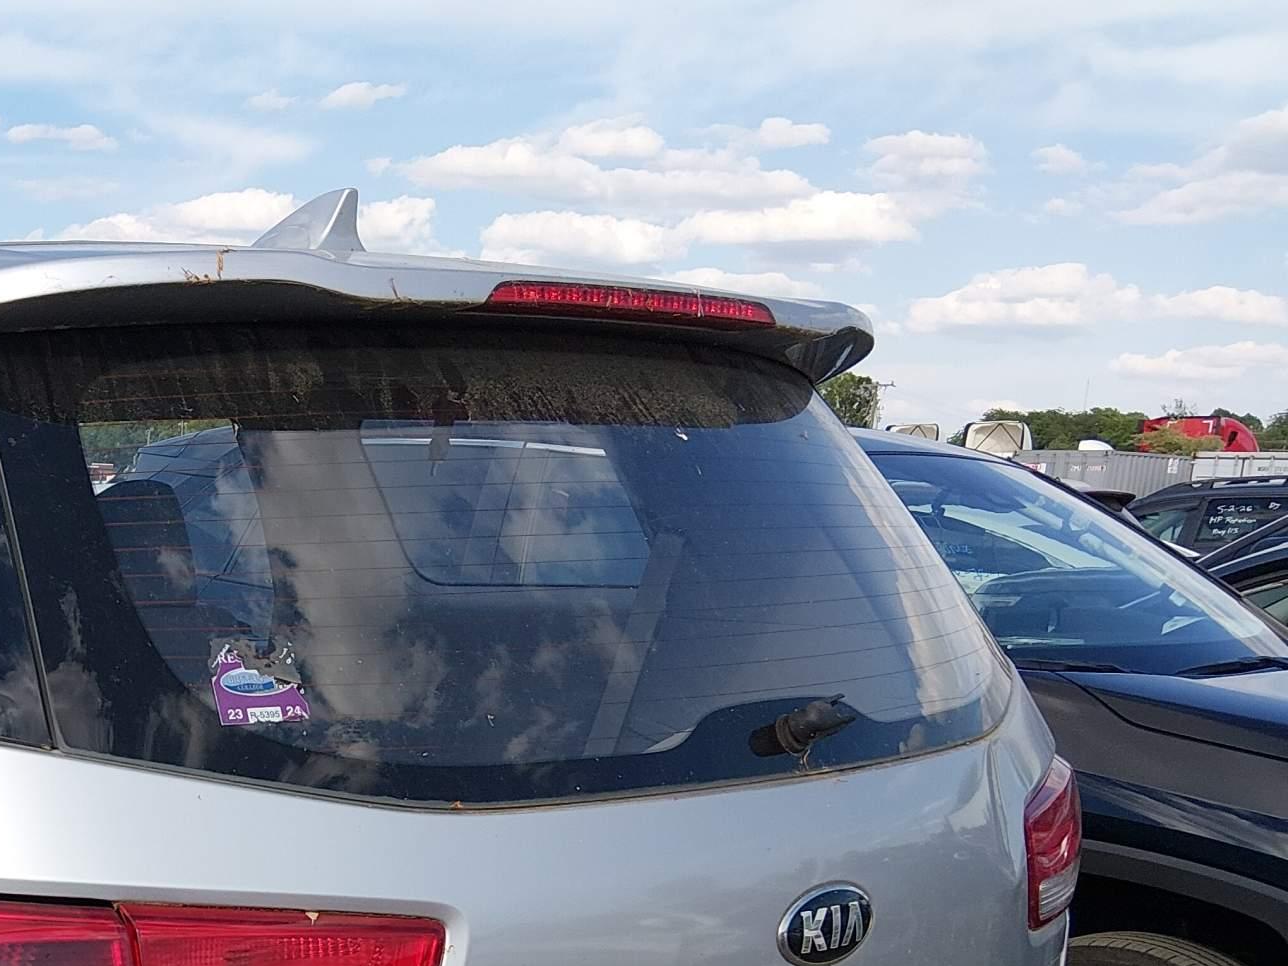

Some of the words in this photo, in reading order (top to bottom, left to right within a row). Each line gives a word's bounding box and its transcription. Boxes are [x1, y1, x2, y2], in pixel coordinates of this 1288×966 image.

[227, 708, 244, 720] 23
[285, 705, 302, 717] 24
[800, 901, 863, 954] KIA
